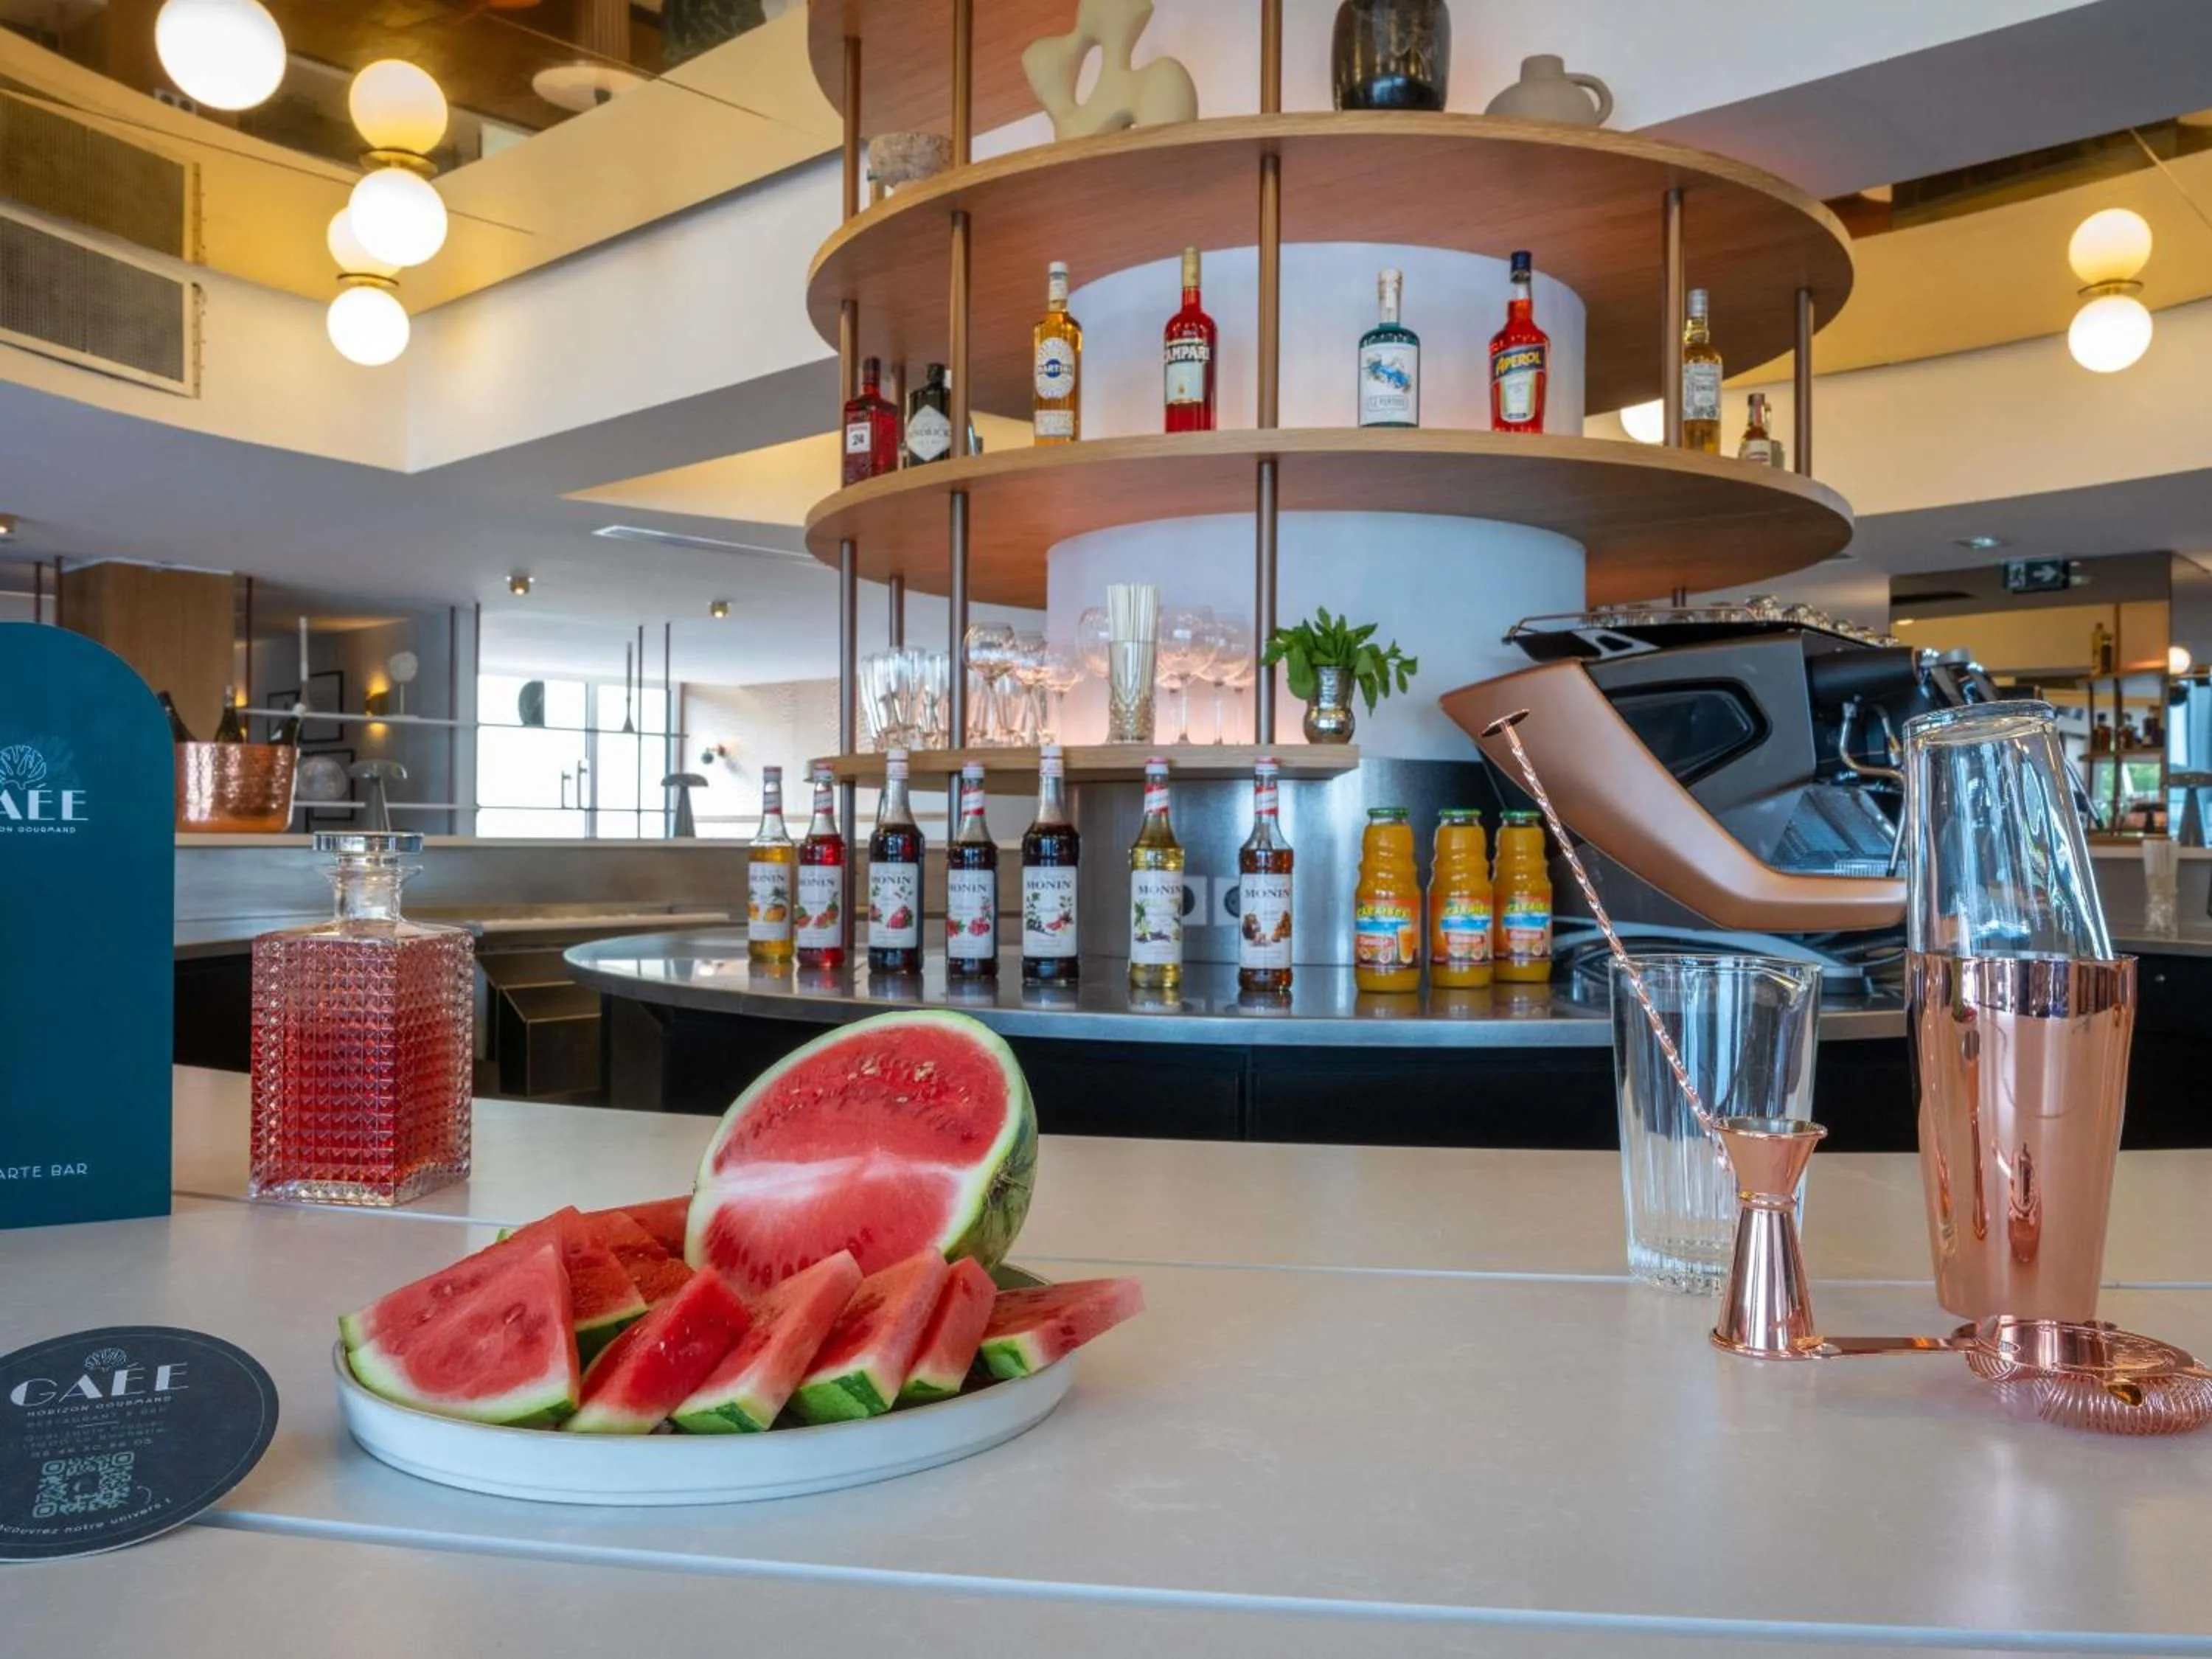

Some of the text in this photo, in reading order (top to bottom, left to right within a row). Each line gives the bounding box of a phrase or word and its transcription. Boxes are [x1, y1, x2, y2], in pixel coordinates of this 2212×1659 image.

[1496, 351, 1542, 375] APEROL
[852, 433, 865, 445] 24
[1244, 887, 1290, 898] MONIN
[50, 1162, 88, 1177] BAR
[27, 1396, 173, 1416] HORIZON GOURMAND
